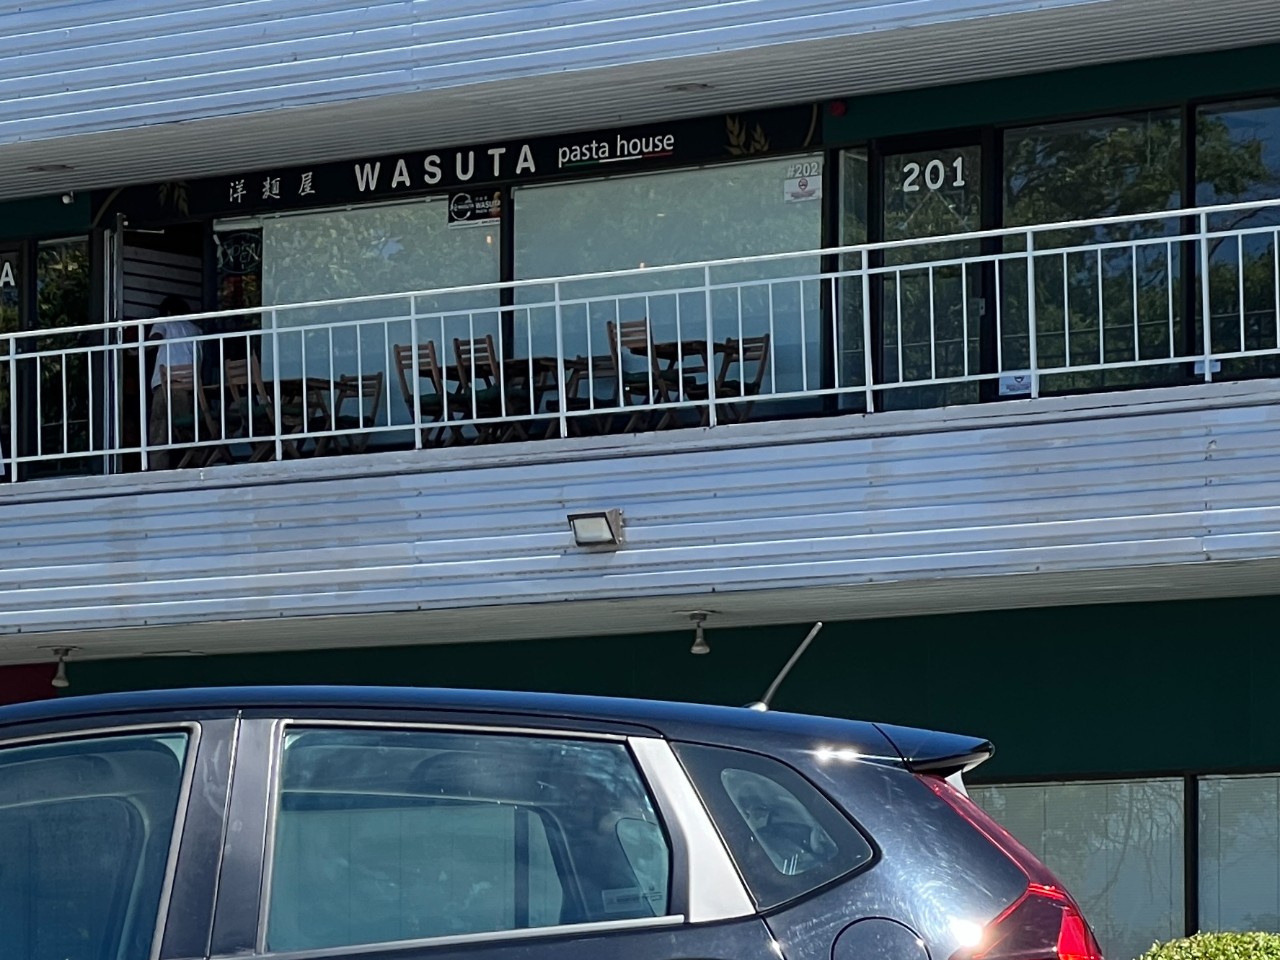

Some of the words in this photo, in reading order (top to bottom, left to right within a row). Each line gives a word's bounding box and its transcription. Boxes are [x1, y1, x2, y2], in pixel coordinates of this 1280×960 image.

[354, 144, 536, 192] WASUTA
[558, 139, 610, 168] pasta
[616, 133, 675, 157] house
[786, 162, 819, 178] #202
[902, 156, 966, 193] 201
